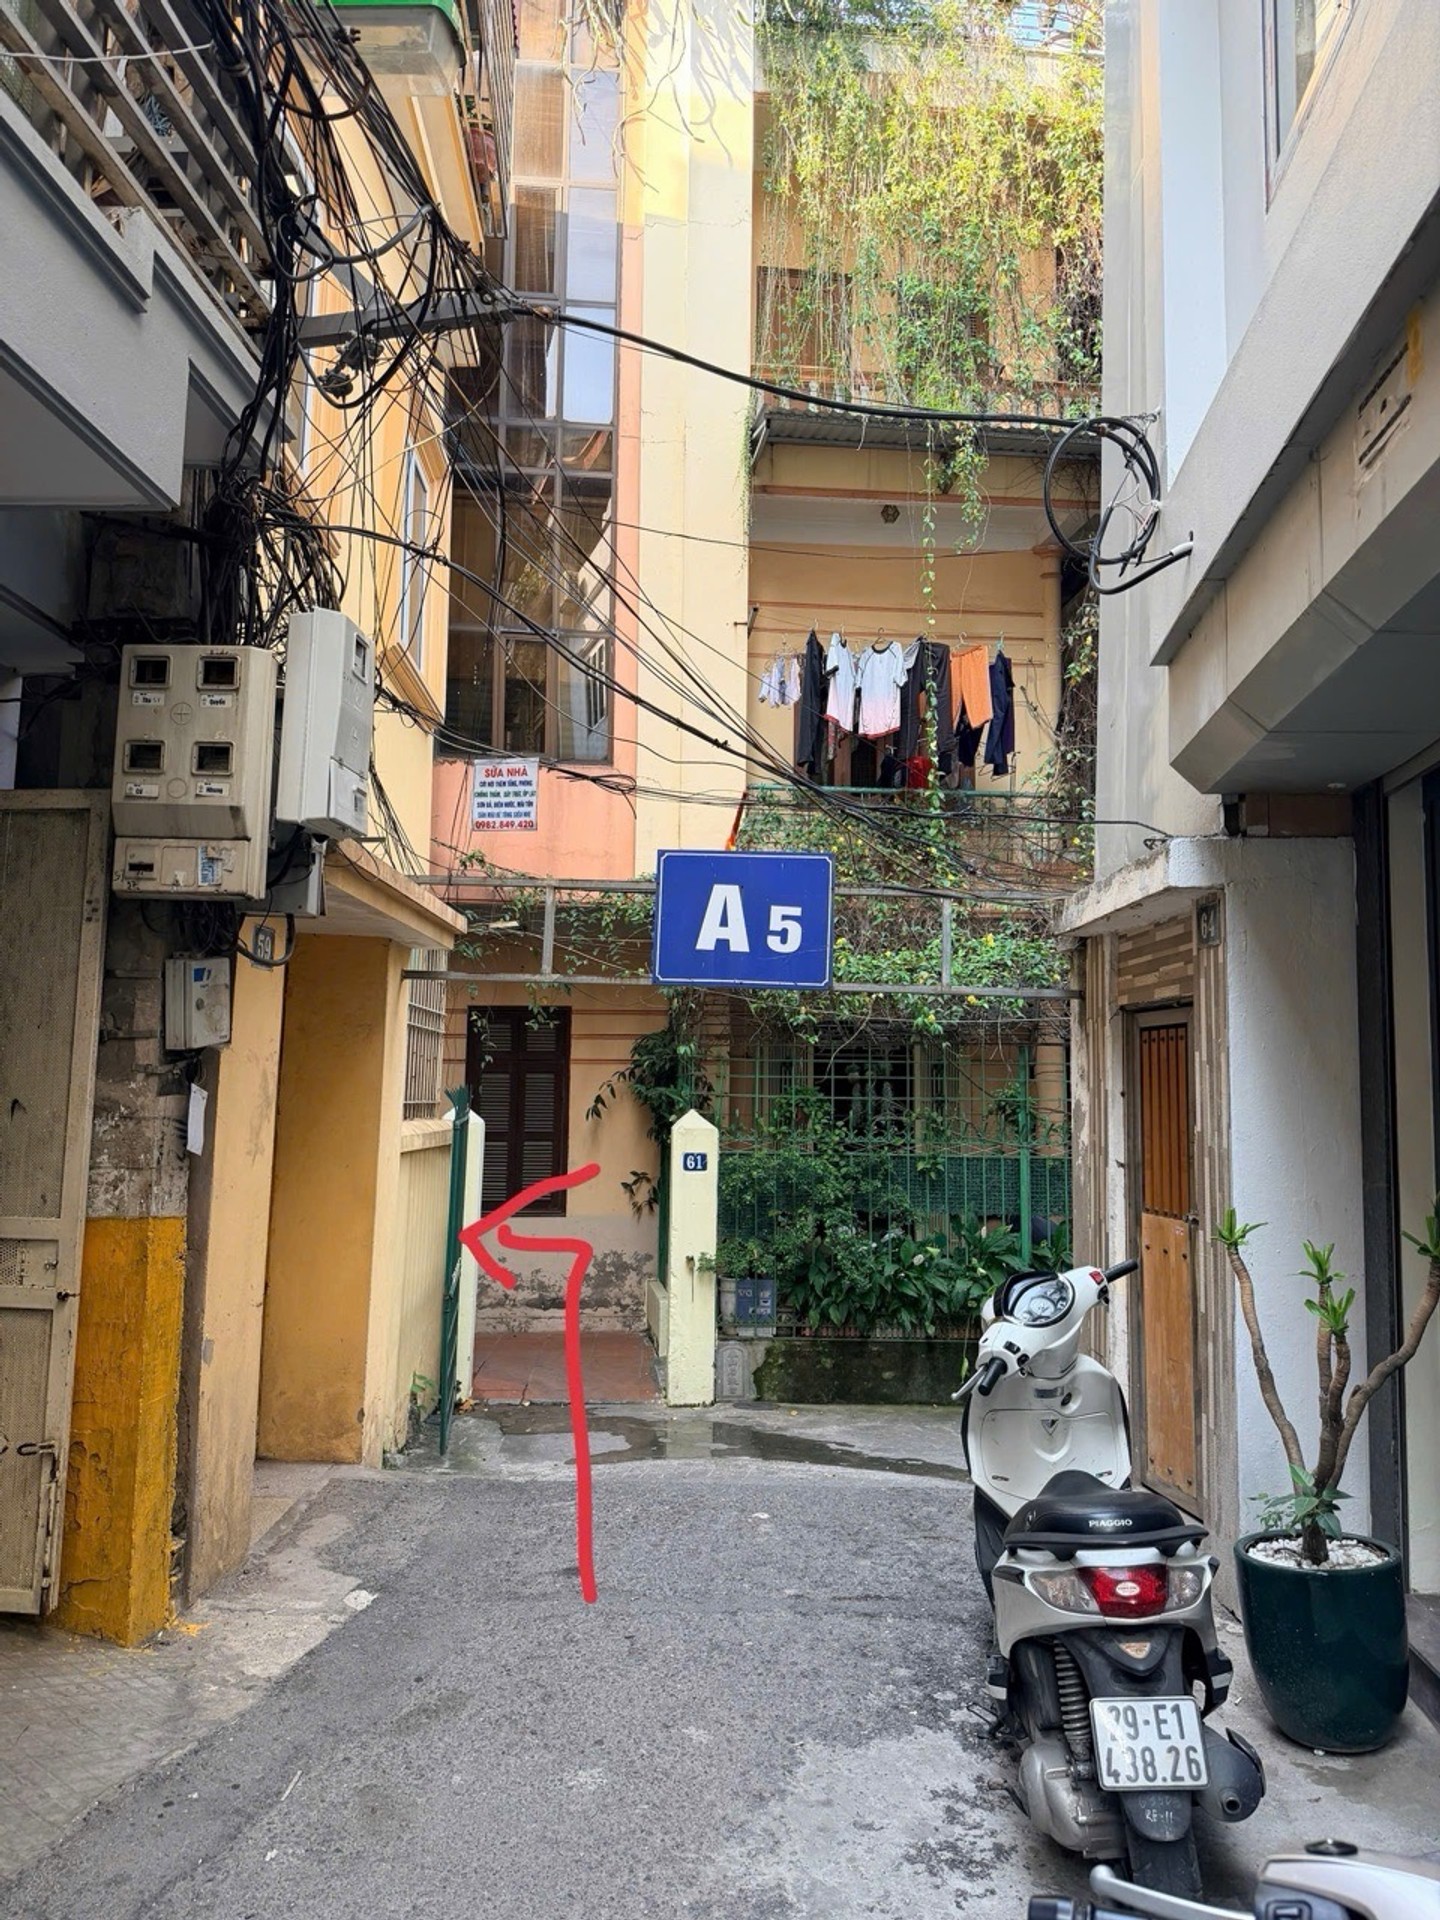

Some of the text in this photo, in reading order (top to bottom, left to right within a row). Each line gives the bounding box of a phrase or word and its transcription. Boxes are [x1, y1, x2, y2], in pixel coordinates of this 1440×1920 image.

[484, 765, 528, 778] SỬA NHÀ
[1201, 910, 1215, 939] 64
[257, 933, 271, 960] 59
[686, 1155, 703, 1169] 61
[1089, 1518, 1133, 1528] PIAGGIO
